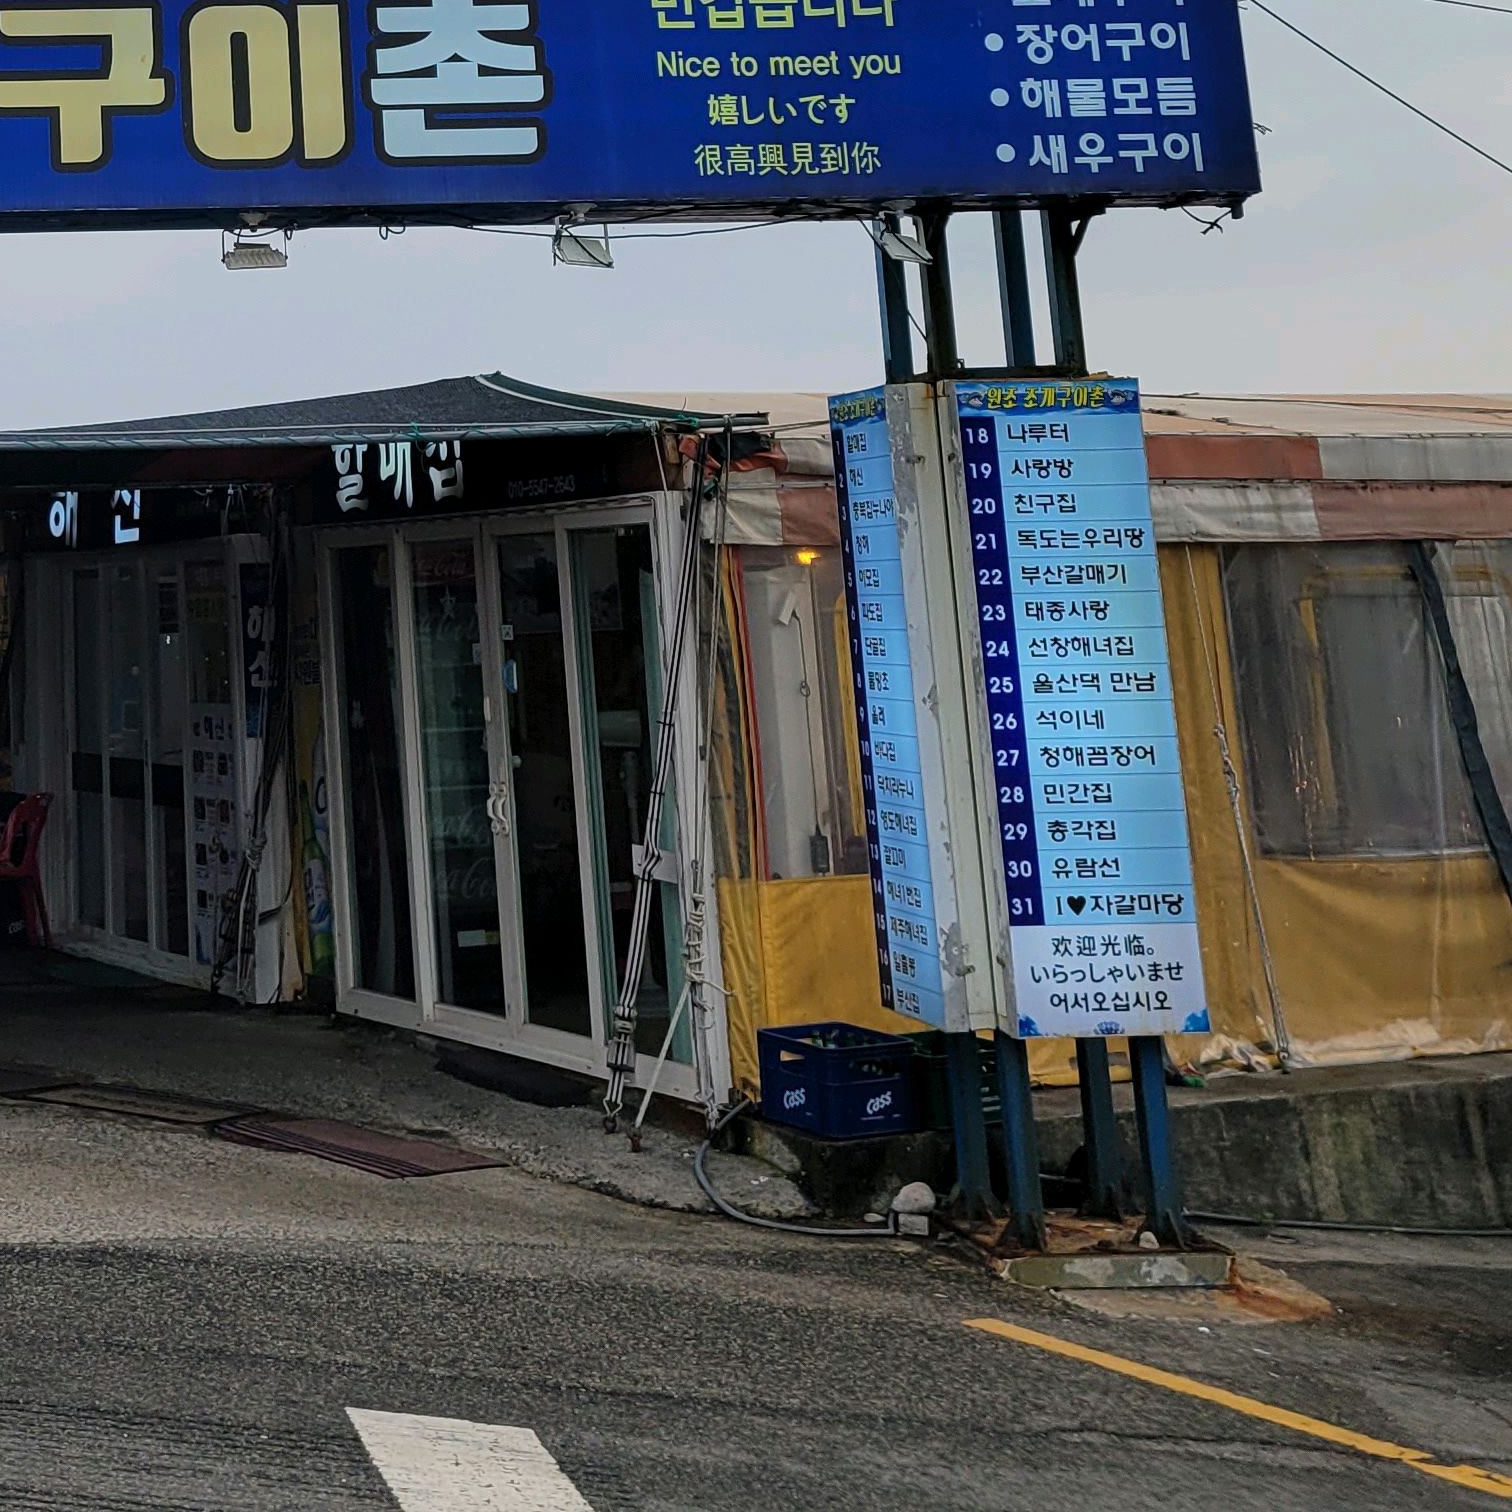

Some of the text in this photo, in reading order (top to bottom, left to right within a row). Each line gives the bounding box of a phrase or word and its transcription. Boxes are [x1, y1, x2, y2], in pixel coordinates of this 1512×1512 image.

[1016, 21, 1191, 65] 장어구이
[657, 50, 902, 81] Nice to meet you
[1019, 76, 1198, 118] 해물모듬
[707, 93, 857, 127] 嬉しいです
[694, 140, 883, 178] 很高興見到你
[1028, 131, 1205, 174] 새우구이
[987, 384, 1107, 409] 원조 조개구이촌
[965, 421, 1069, 445] 18 나루터
[969, 457, 1074, 480] 19 사랑방
[972, 492, 1077, 515] 20 친구집
[975, 528, 1146, 550] 21 독도는우리땅
[979, 563, 1128, 586] 22 부산갈매기
[982, 599, 1110, 622] 23 태종사랑
[864, 636, 887, 656] 단골집
[986, 635, 1135, 658] 24 선창해녀집
[867, 670, 890, 691] 물망초
[989, 672, 1156, 694] 25 울산댁 만남
[993, 709, 1105, 731] 26 석이네
[861, 740, 897, 762] 10 바다집
[996, 745, 1157, 768] 27 청해꼼장어
[863, 774, 872, 791] 11
[1000, 781, 1113, 805] 28 민간집
[866, 808, 918, 836] 12 영도해녀집
[1004, 818, 1117, 842] 29 총각집
[870, 843, 879, 860] 13
[1007, 856, 1121, 879] 30 유람선
[873, 878, 882, 895] 14
[1011, 897, 1034, 915] 31
[876, 914, 929, 945] 15 제주해녀집
[879, 949, 889, 966] 16
[1031, 962, 1184, 985] いらっしゃいませ
[882, 984, 920, 1014] 17 부산집
[1049, 990, 1173, 1013] 어서오십시오
[782, 1087, 806, 1112] Cass
[866, 1090, 892, 1116] Cass
